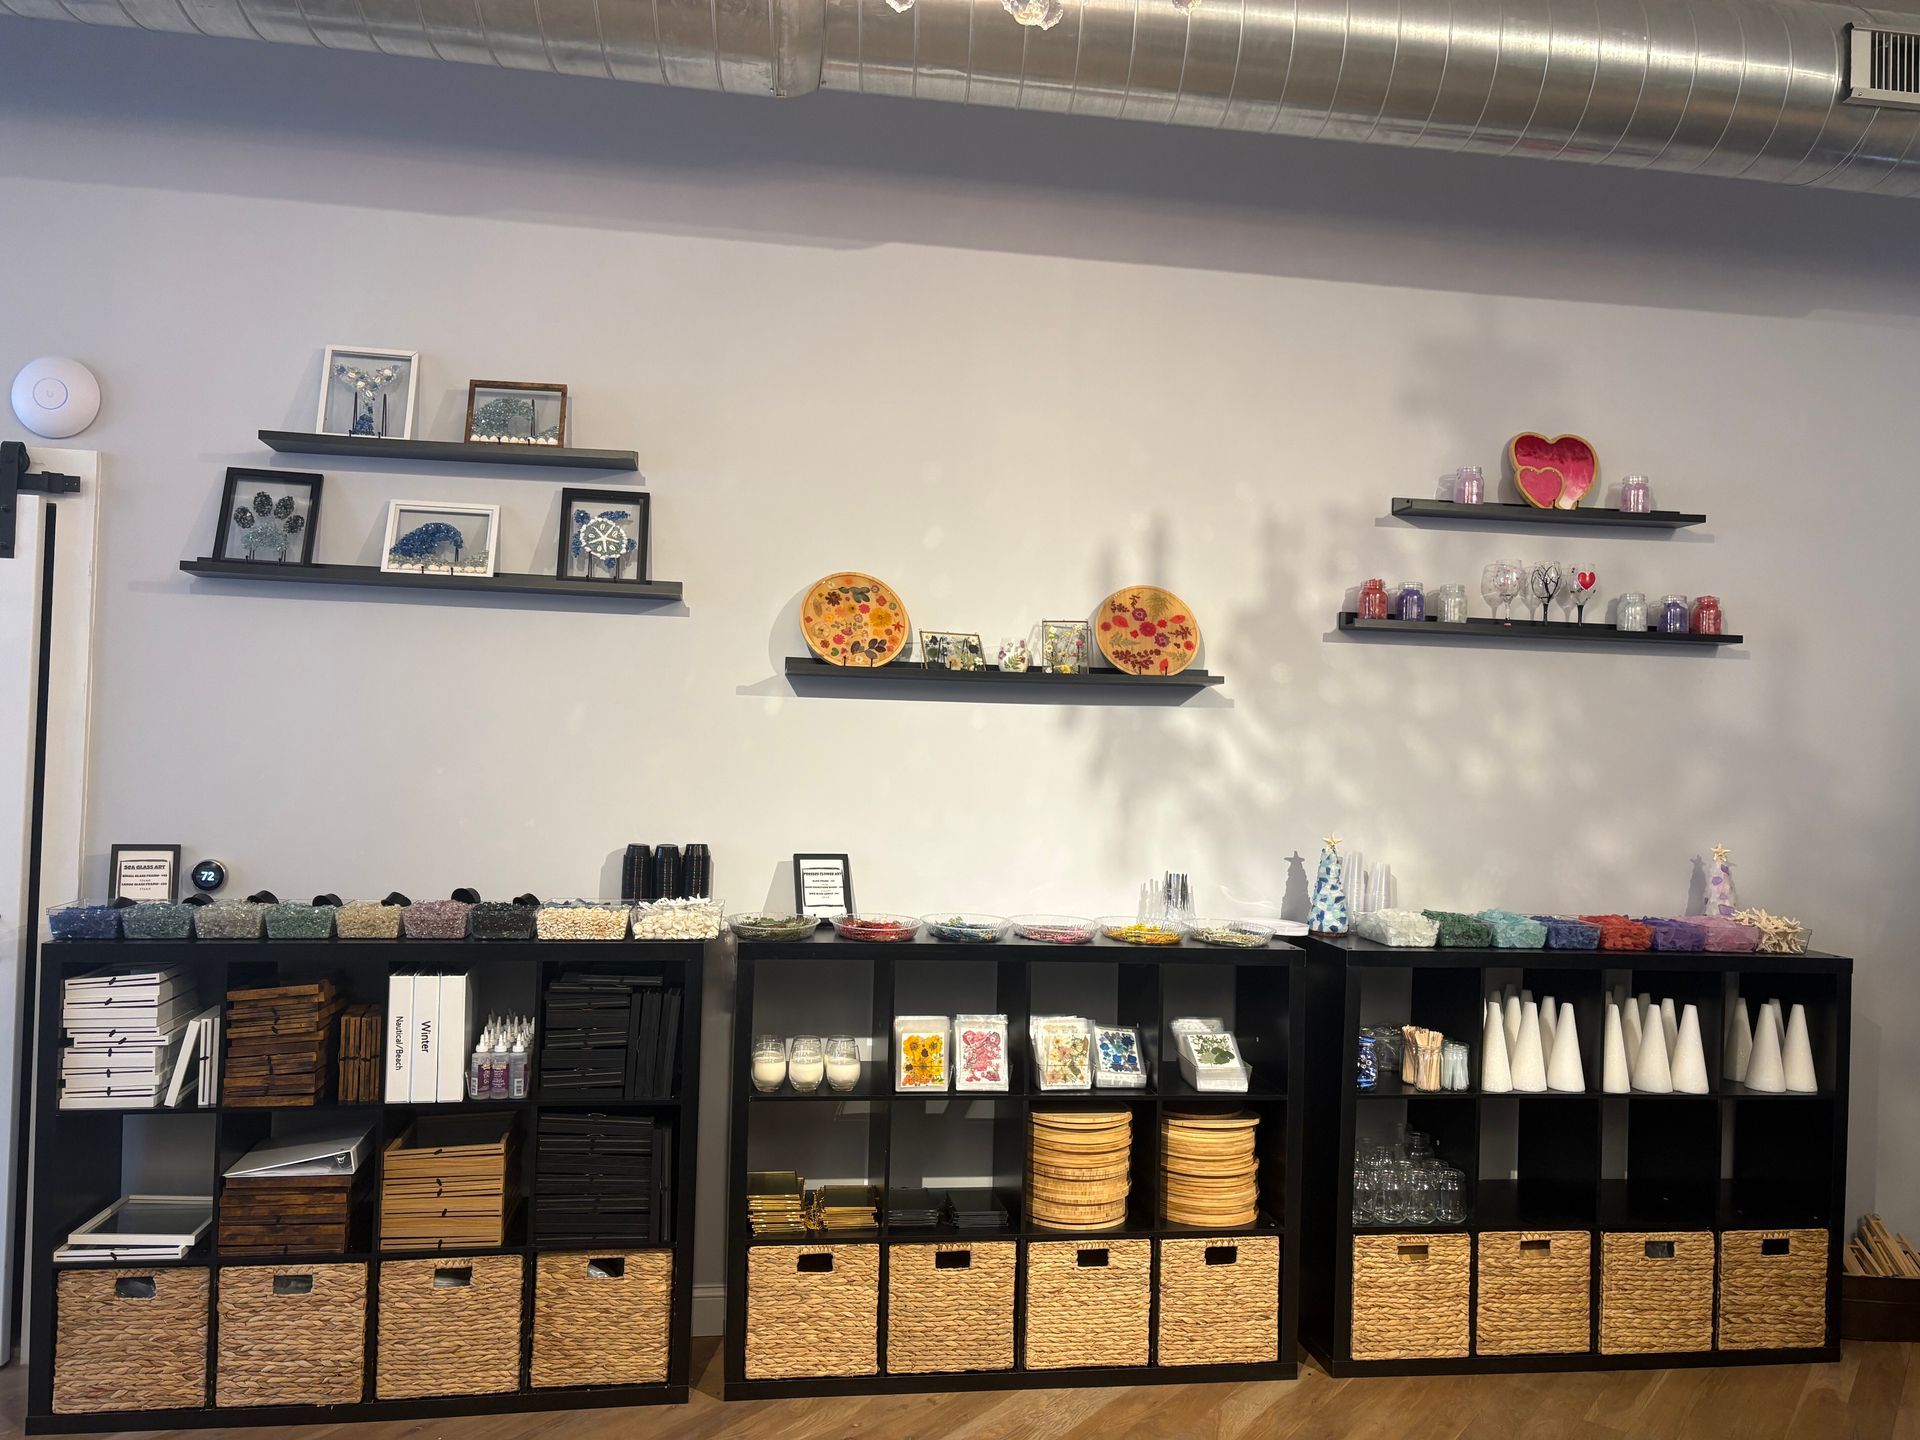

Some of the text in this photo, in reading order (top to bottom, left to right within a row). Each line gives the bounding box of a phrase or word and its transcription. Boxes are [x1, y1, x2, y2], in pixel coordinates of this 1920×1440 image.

[200, 871, 215, 881] 72
[395, 1016, 404, 1071] Nautical/Beach
[421, 1020, 431, 1053] Winter
